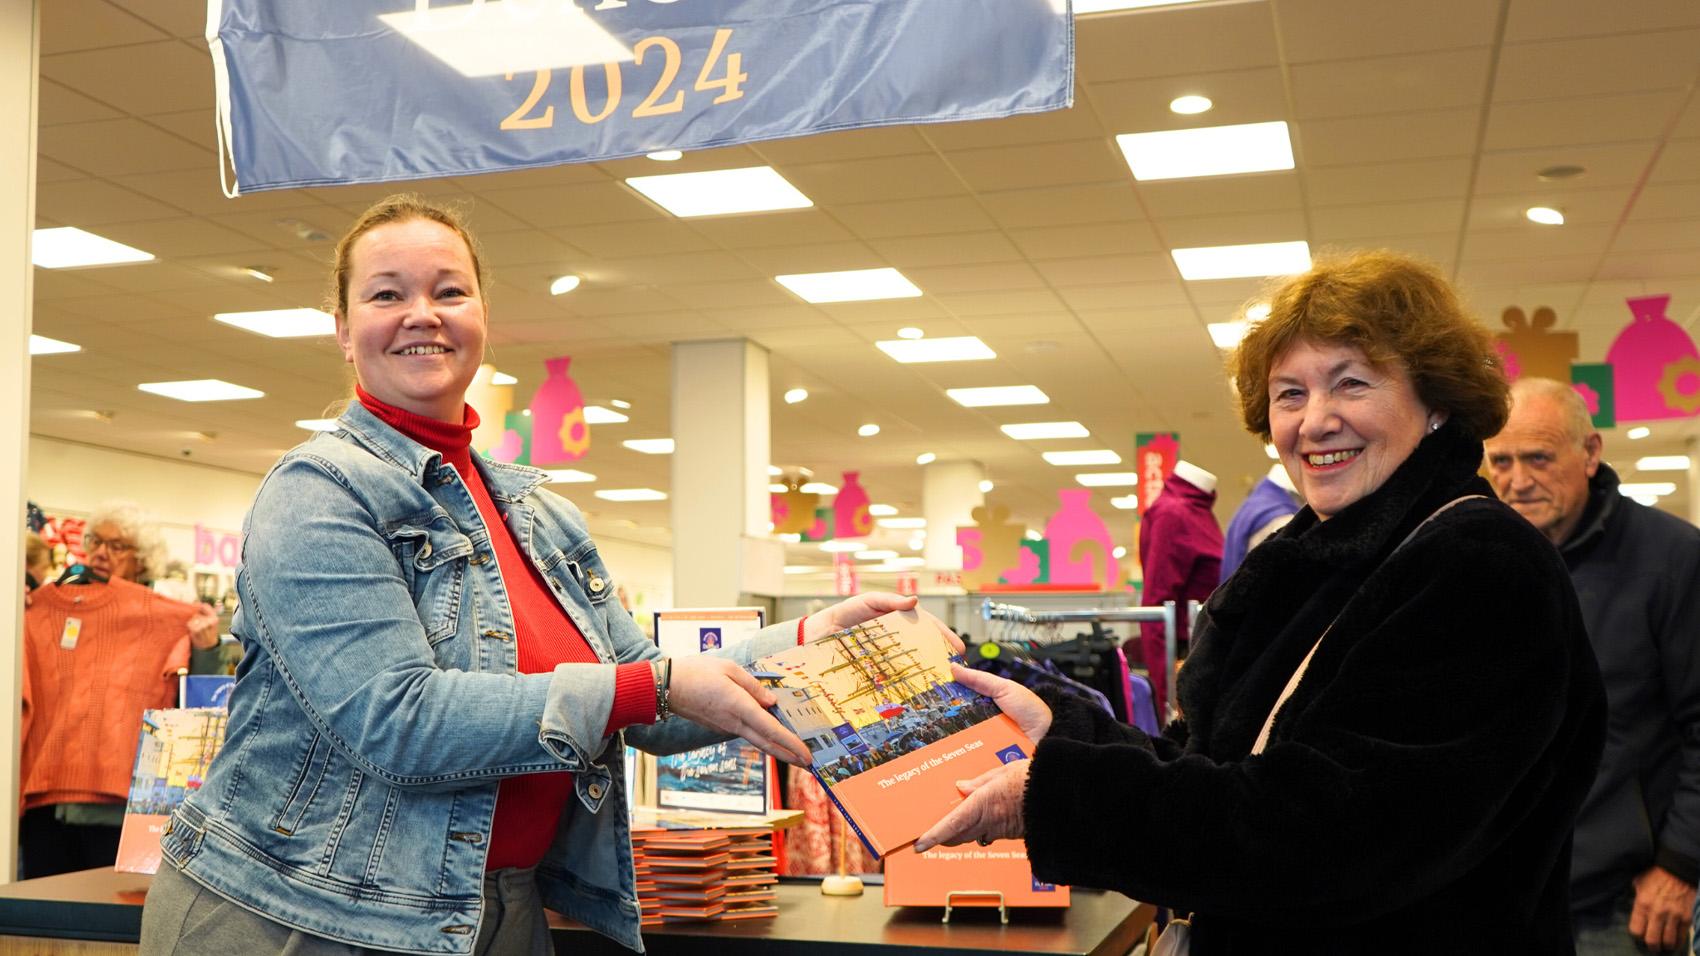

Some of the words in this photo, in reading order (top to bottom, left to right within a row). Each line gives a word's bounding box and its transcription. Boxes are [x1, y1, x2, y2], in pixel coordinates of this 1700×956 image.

[500, 29, 747, 130] 2024
[877, 778, 896, 789] The
[895, 767, 921, 782] legacy
[920, 760, 930, 771] of
[929, 757, 945, 768] the
[942, 746, 966, 761] Seven
[964, 740, 983, 752] Seas
[923, 851, 938, 860] The
[939, 851, 962, 861] legacy
[963, 851, 972, 859] of
[973, 851, 987, 859] the
[987, 851, 1010, 859] Seven
